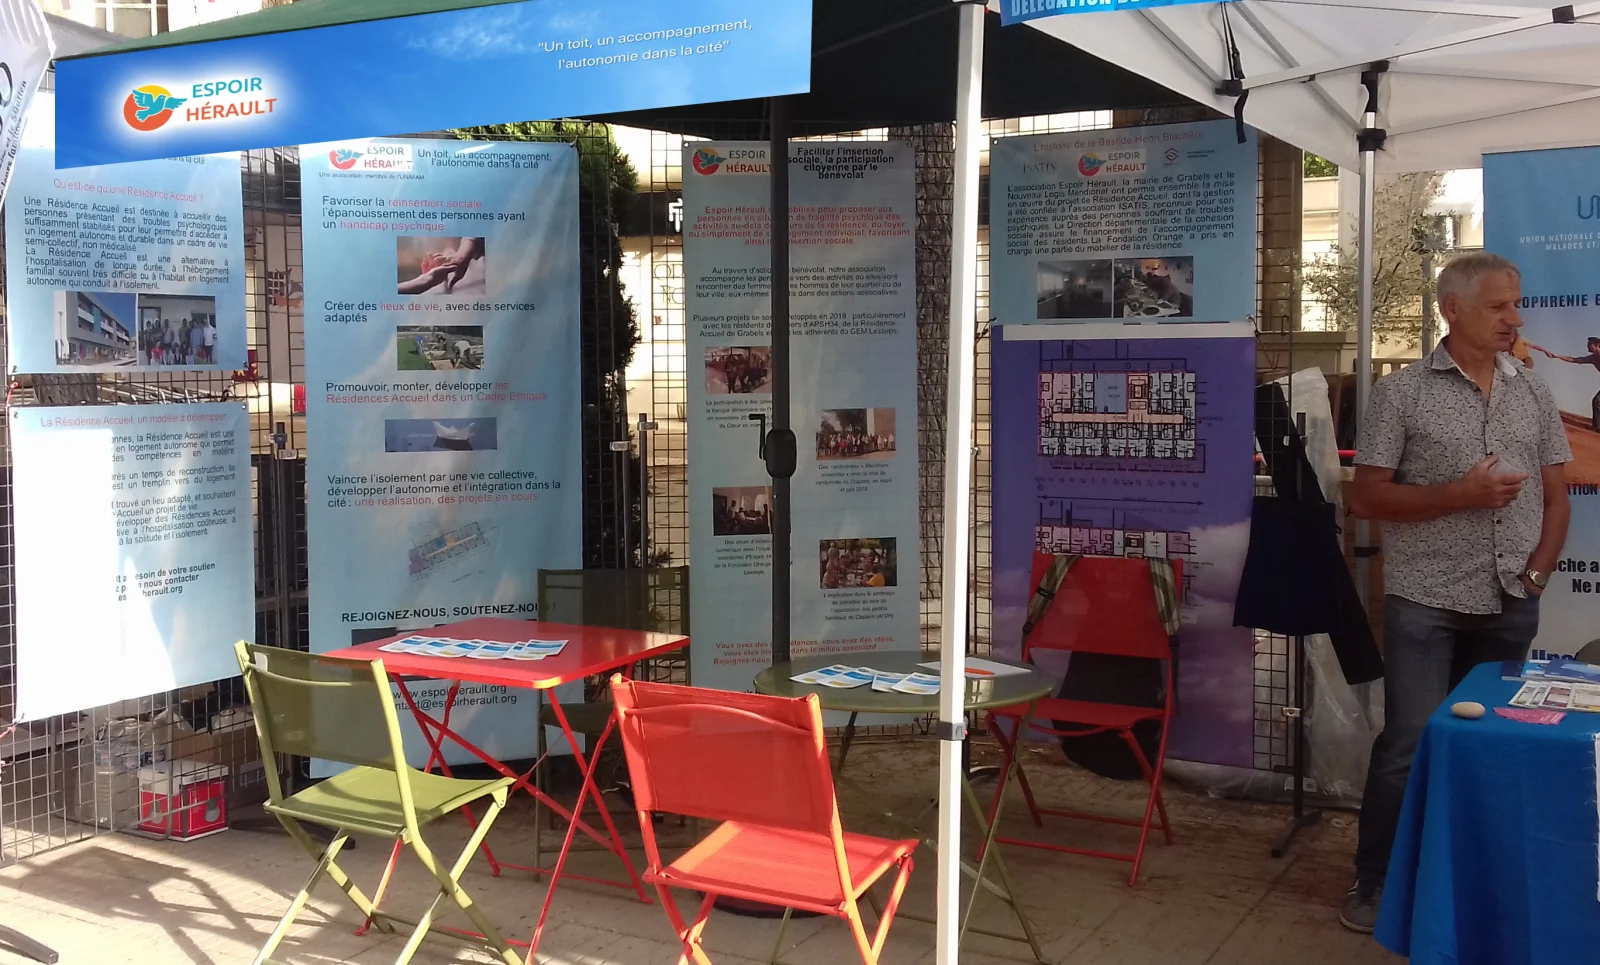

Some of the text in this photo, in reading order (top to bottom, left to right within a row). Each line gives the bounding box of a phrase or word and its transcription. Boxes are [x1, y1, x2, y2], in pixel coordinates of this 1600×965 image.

[1011, 0, 1111, 16] DELEGA
[538, 19, 753, 52] "Un toit, un accompagnement,
[558, 40, 730, 69] l'autonomie dans la cité"
[192, 77, 263, 98] ESPOIR
[186, 98, 278, 122] HÉRAULT
[367, 146, 405, 156] ESPOIR
[418, 149, 431, 158] Un
[434, 150, 450, 159] toit,
[468, 152, 552, 162] accompagnement,
[729, 150, 766, 159] ESPOIR
[798, 147, 884, 156] Faciliter l'insertion
[1108, 152, 1140, 160] ESPOIR
[364, 158, 412, 170] HÉRAT
[432, 158, 539, 168] l'autonomie dans la cité
[788, 155, 894, 165] sociale, la participation
[726, 162, 772, 172] HÉRAULT
[804, 163, 878, 173] citoyenne par le
[1106, 162, 1146, 172] HÉRAULT
[1007, 183, 1056, 192] L'association
[1058, 181, 1084, 190] Espoir
[1134, 176, 1159, 184] mairie
[1177, 173, 1210, 182] Grabels
[1214, 172, 1223, 180] et
[322, 196, 482, 208] Favoriser la réinsertion sociale
[24, 196, 41, 206] Une
[47, 198, 88, 210] Résidence
[92, 202, 120, 213] Accueil
[124, 206, 136, 214] est
[140, 208, 170, 218] destinée
[174, 210, 178, 218] à
[215, 214, 226, 222] des
[322, 208, 526, 222] l'épanouissement des personnes ayant
[340, 220, 388, 231] handicap
[391, 221, 444, 232] psychique
[25, 236, 136, 252] semi-collectif, non médicalisé
[1520, 232, 1593, 244] UNION NATIONALE
[1545, 242, 1583, 251] MALADES
[26, 277, 66, 286] autonome
[68, 279, 80, 288] qui
[82, 279, 110, 288] conduit
[112, 280, 118, 288] à
[324, 300, 355, 310] Créer
[358, 301, 377, 310] des
[380, 301, 405, 310] lieux
[408, 302, 420, 310] de
[424, 302, 442, 312] vie,
[472, 302, 492, 311] des
[494, 302, 535, 310] services
[1514, 294, 1588, 309] OPHRENIE
[324, 312, 368, 324] adaptés
[326, 381, 508, 393] Promouvoir, monter, développer les
[326, 391, 548, 404] Résidences Accueil dans un Cadre Ethique
[328, 474, 368, 484] Vaincre
[370, 474, 426, 483] l'isolement
[430, 474, 446, 483] par
[470, 472, 484, 480] vie
[488, 470, 537, 480] collective,
[328, 480, 560, 497] développer l'autonomie et l'intégration dans la
[378, 496, 434, 505] réalisation,
[438, 495, 456, 504] des
[458, 493, 492, 504] projets
[496, 494, 508, 502] en
[512, 493, 538, 501] cours
[157, 562, 216, 577] de votre soutien
[144, 579, 162, 588] nous
[164, 573, 200, 585] contacter
[1572, 579, 1592, 594] Ne
[342, 602, 538, 622] REJOIGNEZ-NOUS, SOUTENEZ-NO
